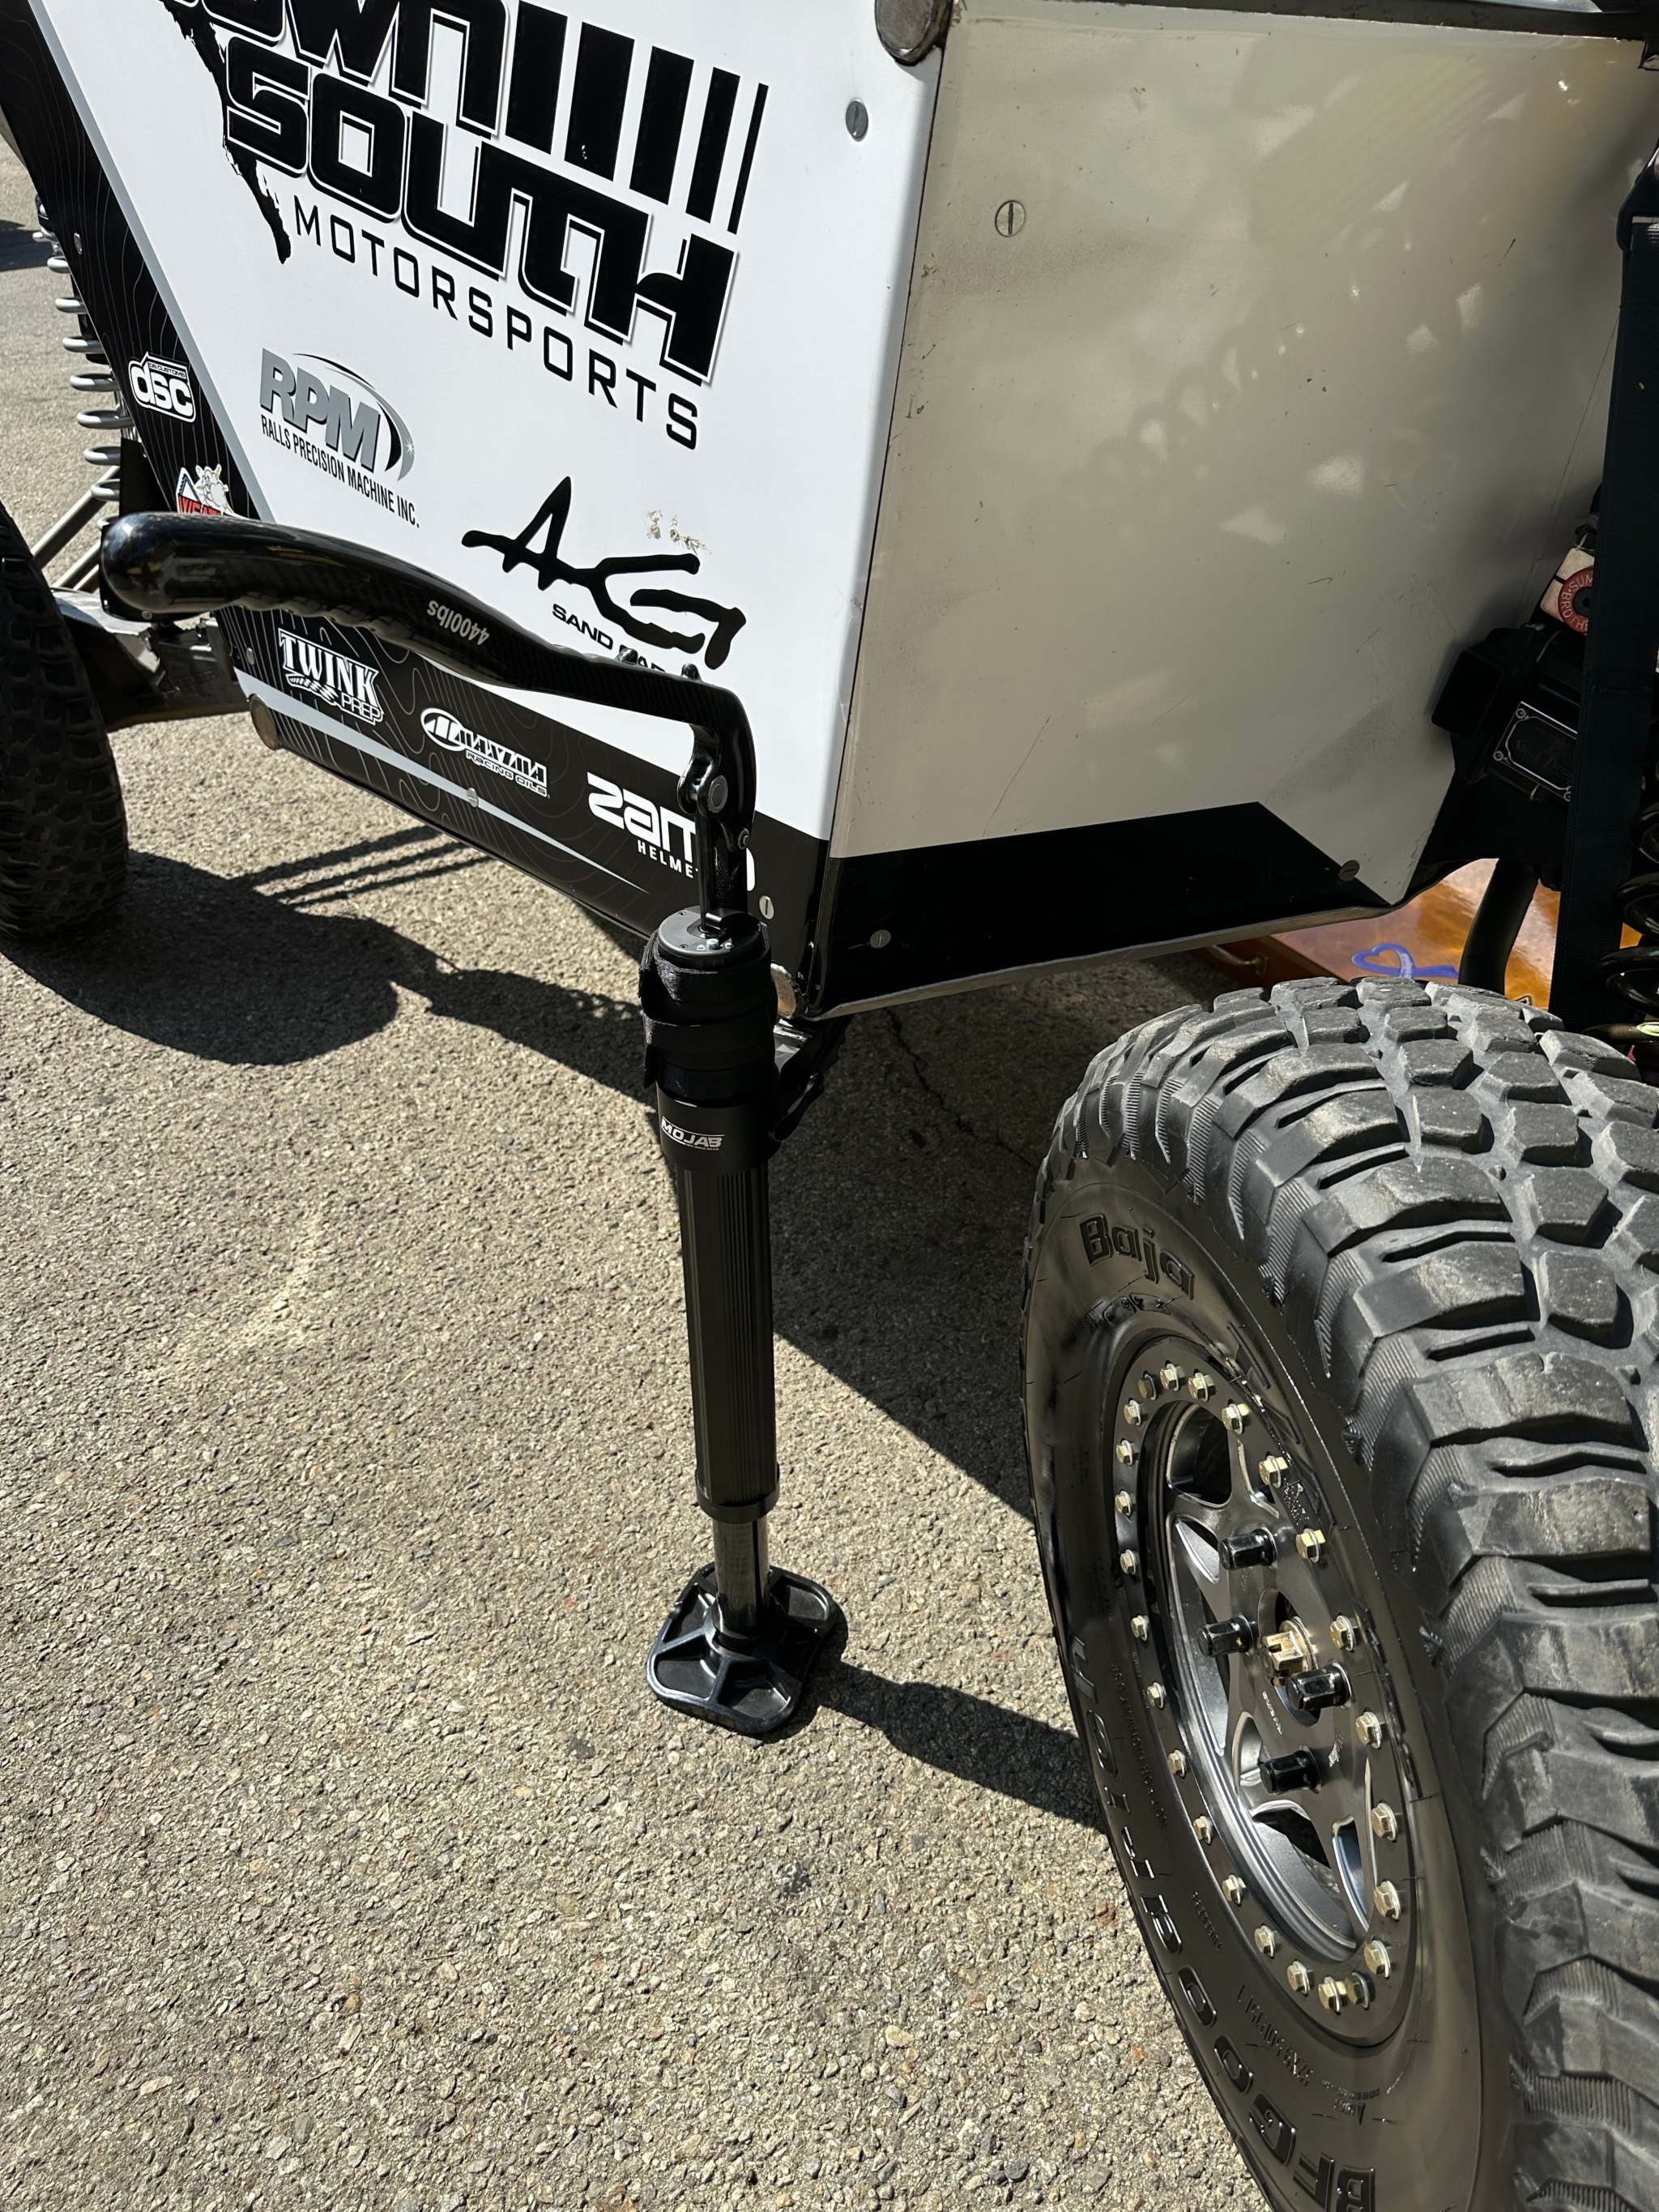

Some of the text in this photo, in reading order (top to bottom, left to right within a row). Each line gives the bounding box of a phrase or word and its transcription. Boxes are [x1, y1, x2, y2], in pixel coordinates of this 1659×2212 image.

[226, 36, 738, 387] SOUTH
[296, 195, 698, 451] MOTORSPORTS
[260, 348, 381, 473] RPM
[261, 414, 420, 528] RALLS PRECISION MACHINE INC.
[427, 600, 490, 646] 4400lbs
[552, 604, 613, 650] SAND
[279, 628, 380, 708] TWINK
[341, 691, 381, 721] PREP
[452, 728, 548, 789] MAXIMA
[465, 749, 548, 798] RACING OILS
[637, 839, 700, 880] HELME
[1080, 1214, 1195, 1300] Baja
